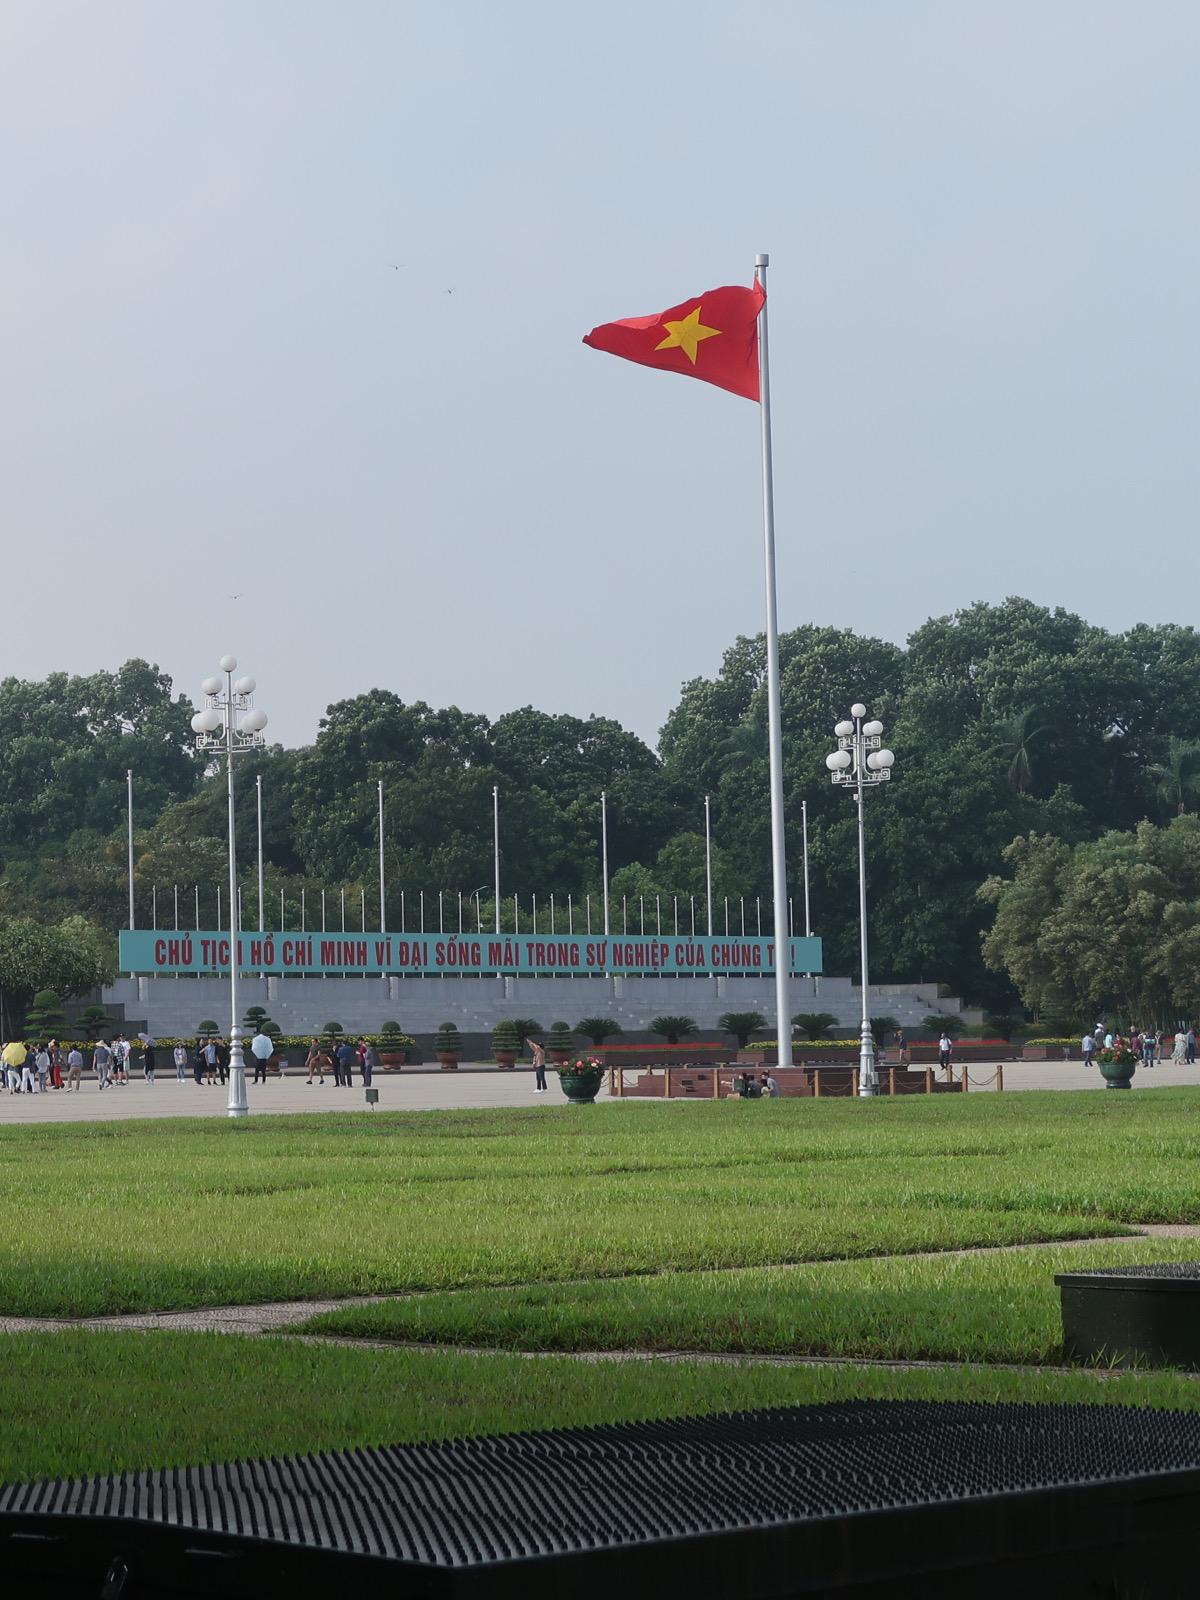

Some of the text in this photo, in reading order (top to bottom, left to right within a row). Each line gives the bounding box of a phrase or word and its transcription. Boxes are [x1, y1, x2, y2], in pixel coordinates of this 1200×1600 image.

[155, 932, 192, 966] CHỦ
[251, 933, 274, 966] HỒ
[283, 936, 312, 966] CHÍ
[321, 941, 367, 966] MINH
[375, 936, 392, 966] VĨ
[399, 941, 428, 971] ĐẠI
[435, 935, 481, 967] SỐNG
[488, 938, 519, 966] MÃI
[526, 942, 580, 967] TRONG
[586, 940, 607, 971] SỰ
[612, 939, 670, 971] NGHIỆP
[675, 937, 705, 967] CỦA
[711, 939, 761, 967] CHÚNG
